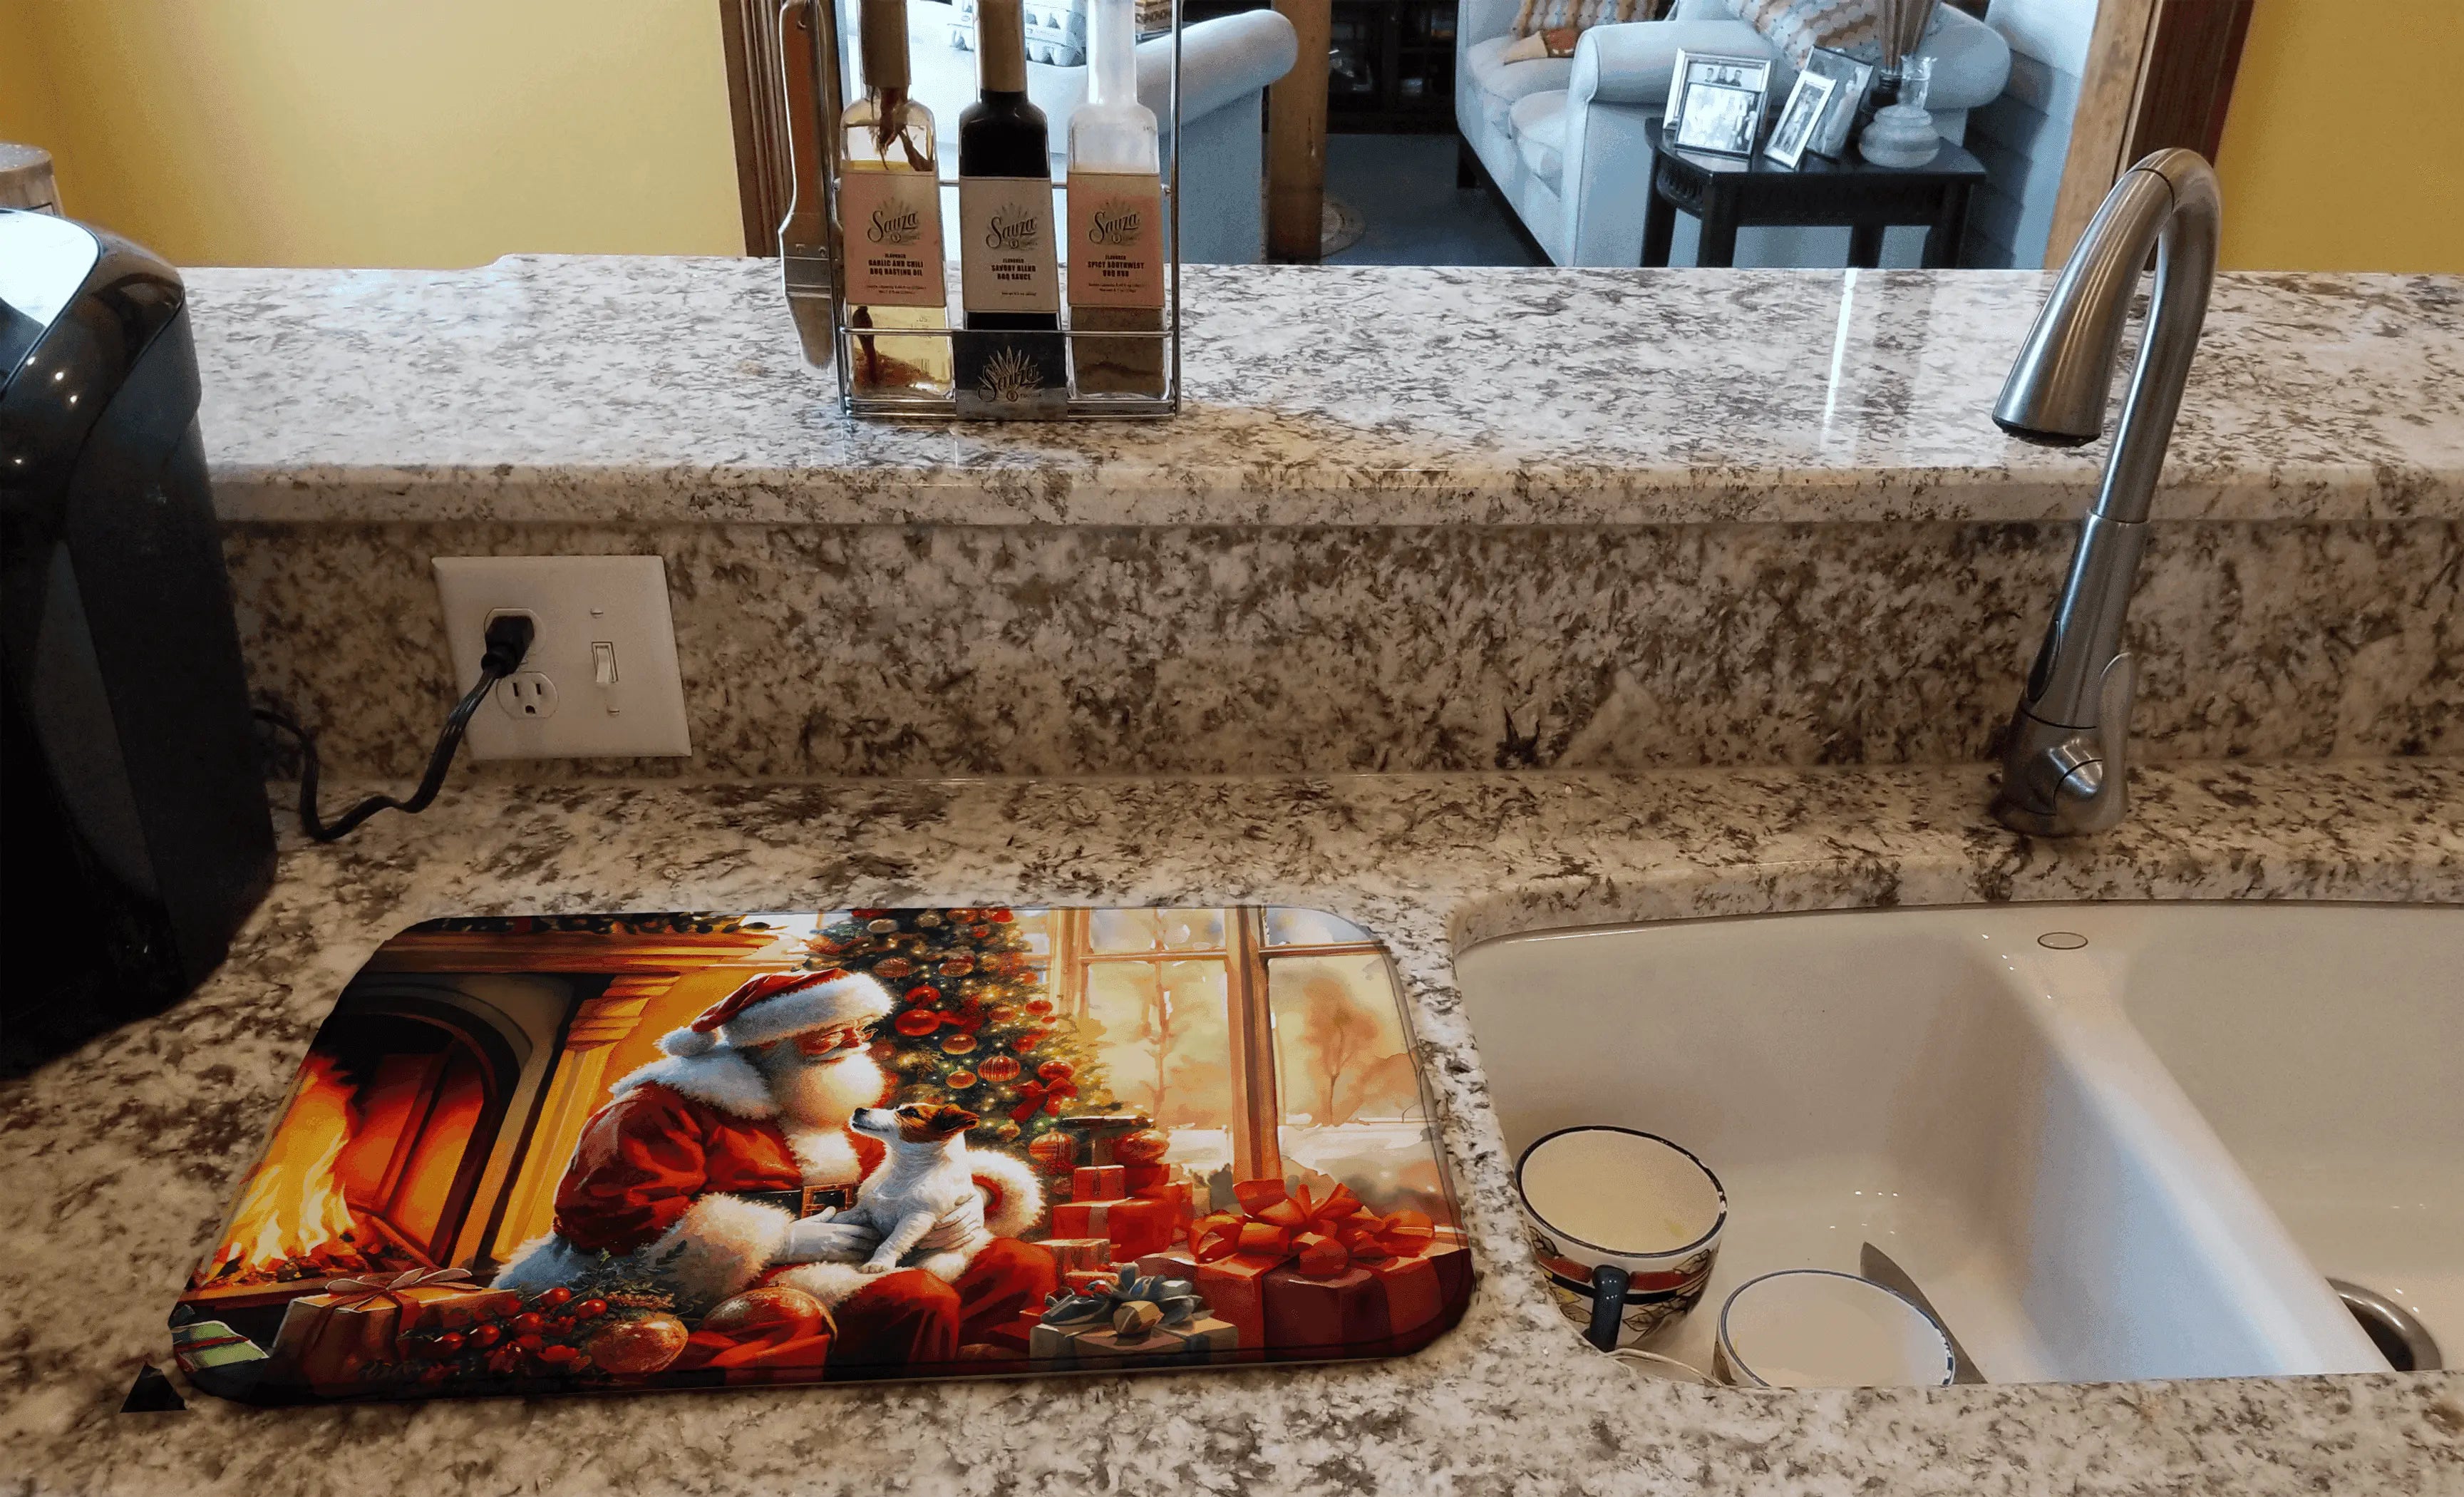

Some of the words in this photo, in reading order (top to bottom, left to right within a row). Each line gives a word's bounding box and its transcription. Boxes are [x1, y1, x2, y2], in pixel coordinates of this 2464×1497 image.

[867, 210, 919, 242] Sauza
[986, 216, 1038, 249] Sauza
[1088, 211, 1140, 244] Sauza
